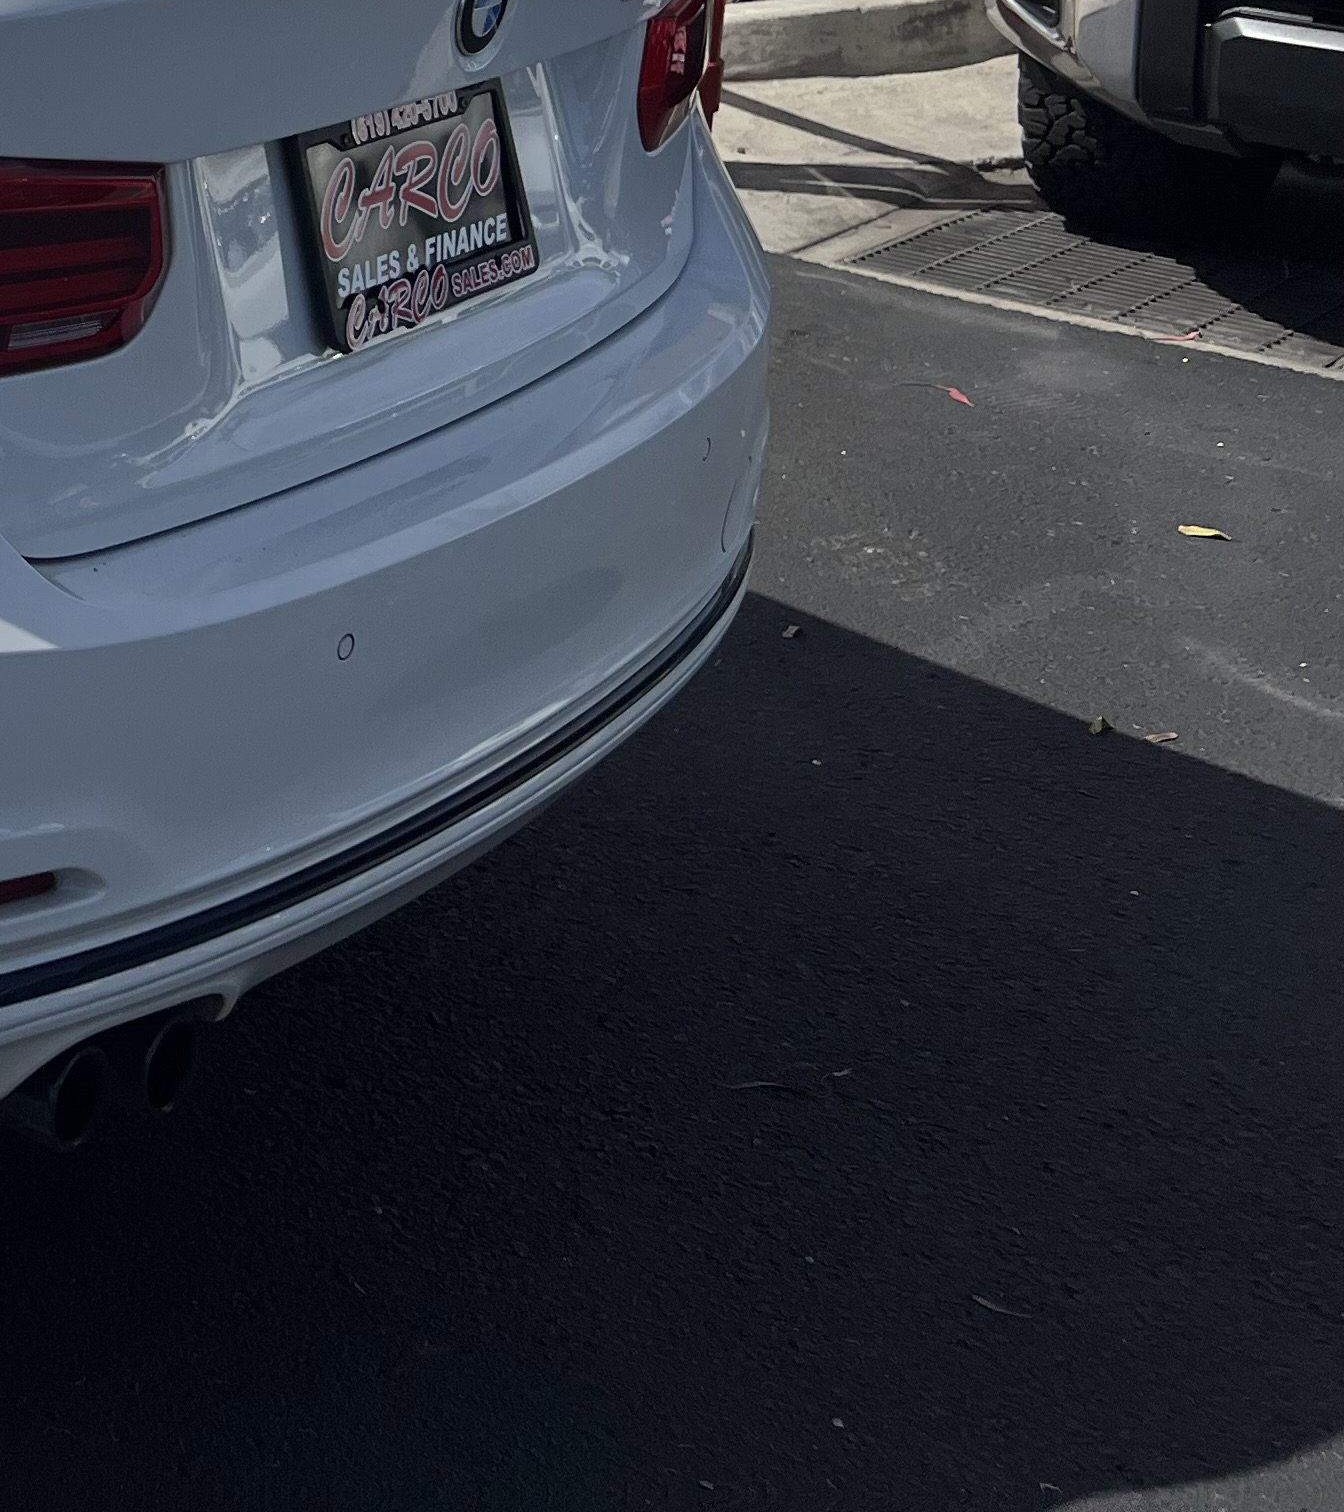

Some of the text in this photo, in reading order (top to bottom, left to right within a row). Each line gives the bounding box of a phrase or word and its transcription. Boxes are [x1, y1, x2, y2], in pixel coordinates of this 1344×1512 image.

[320, 118, 502, 263] CARCO
[337, 213, 508, 299] SALES & FINANCE
[346, 263, 450, 351] CARCO
